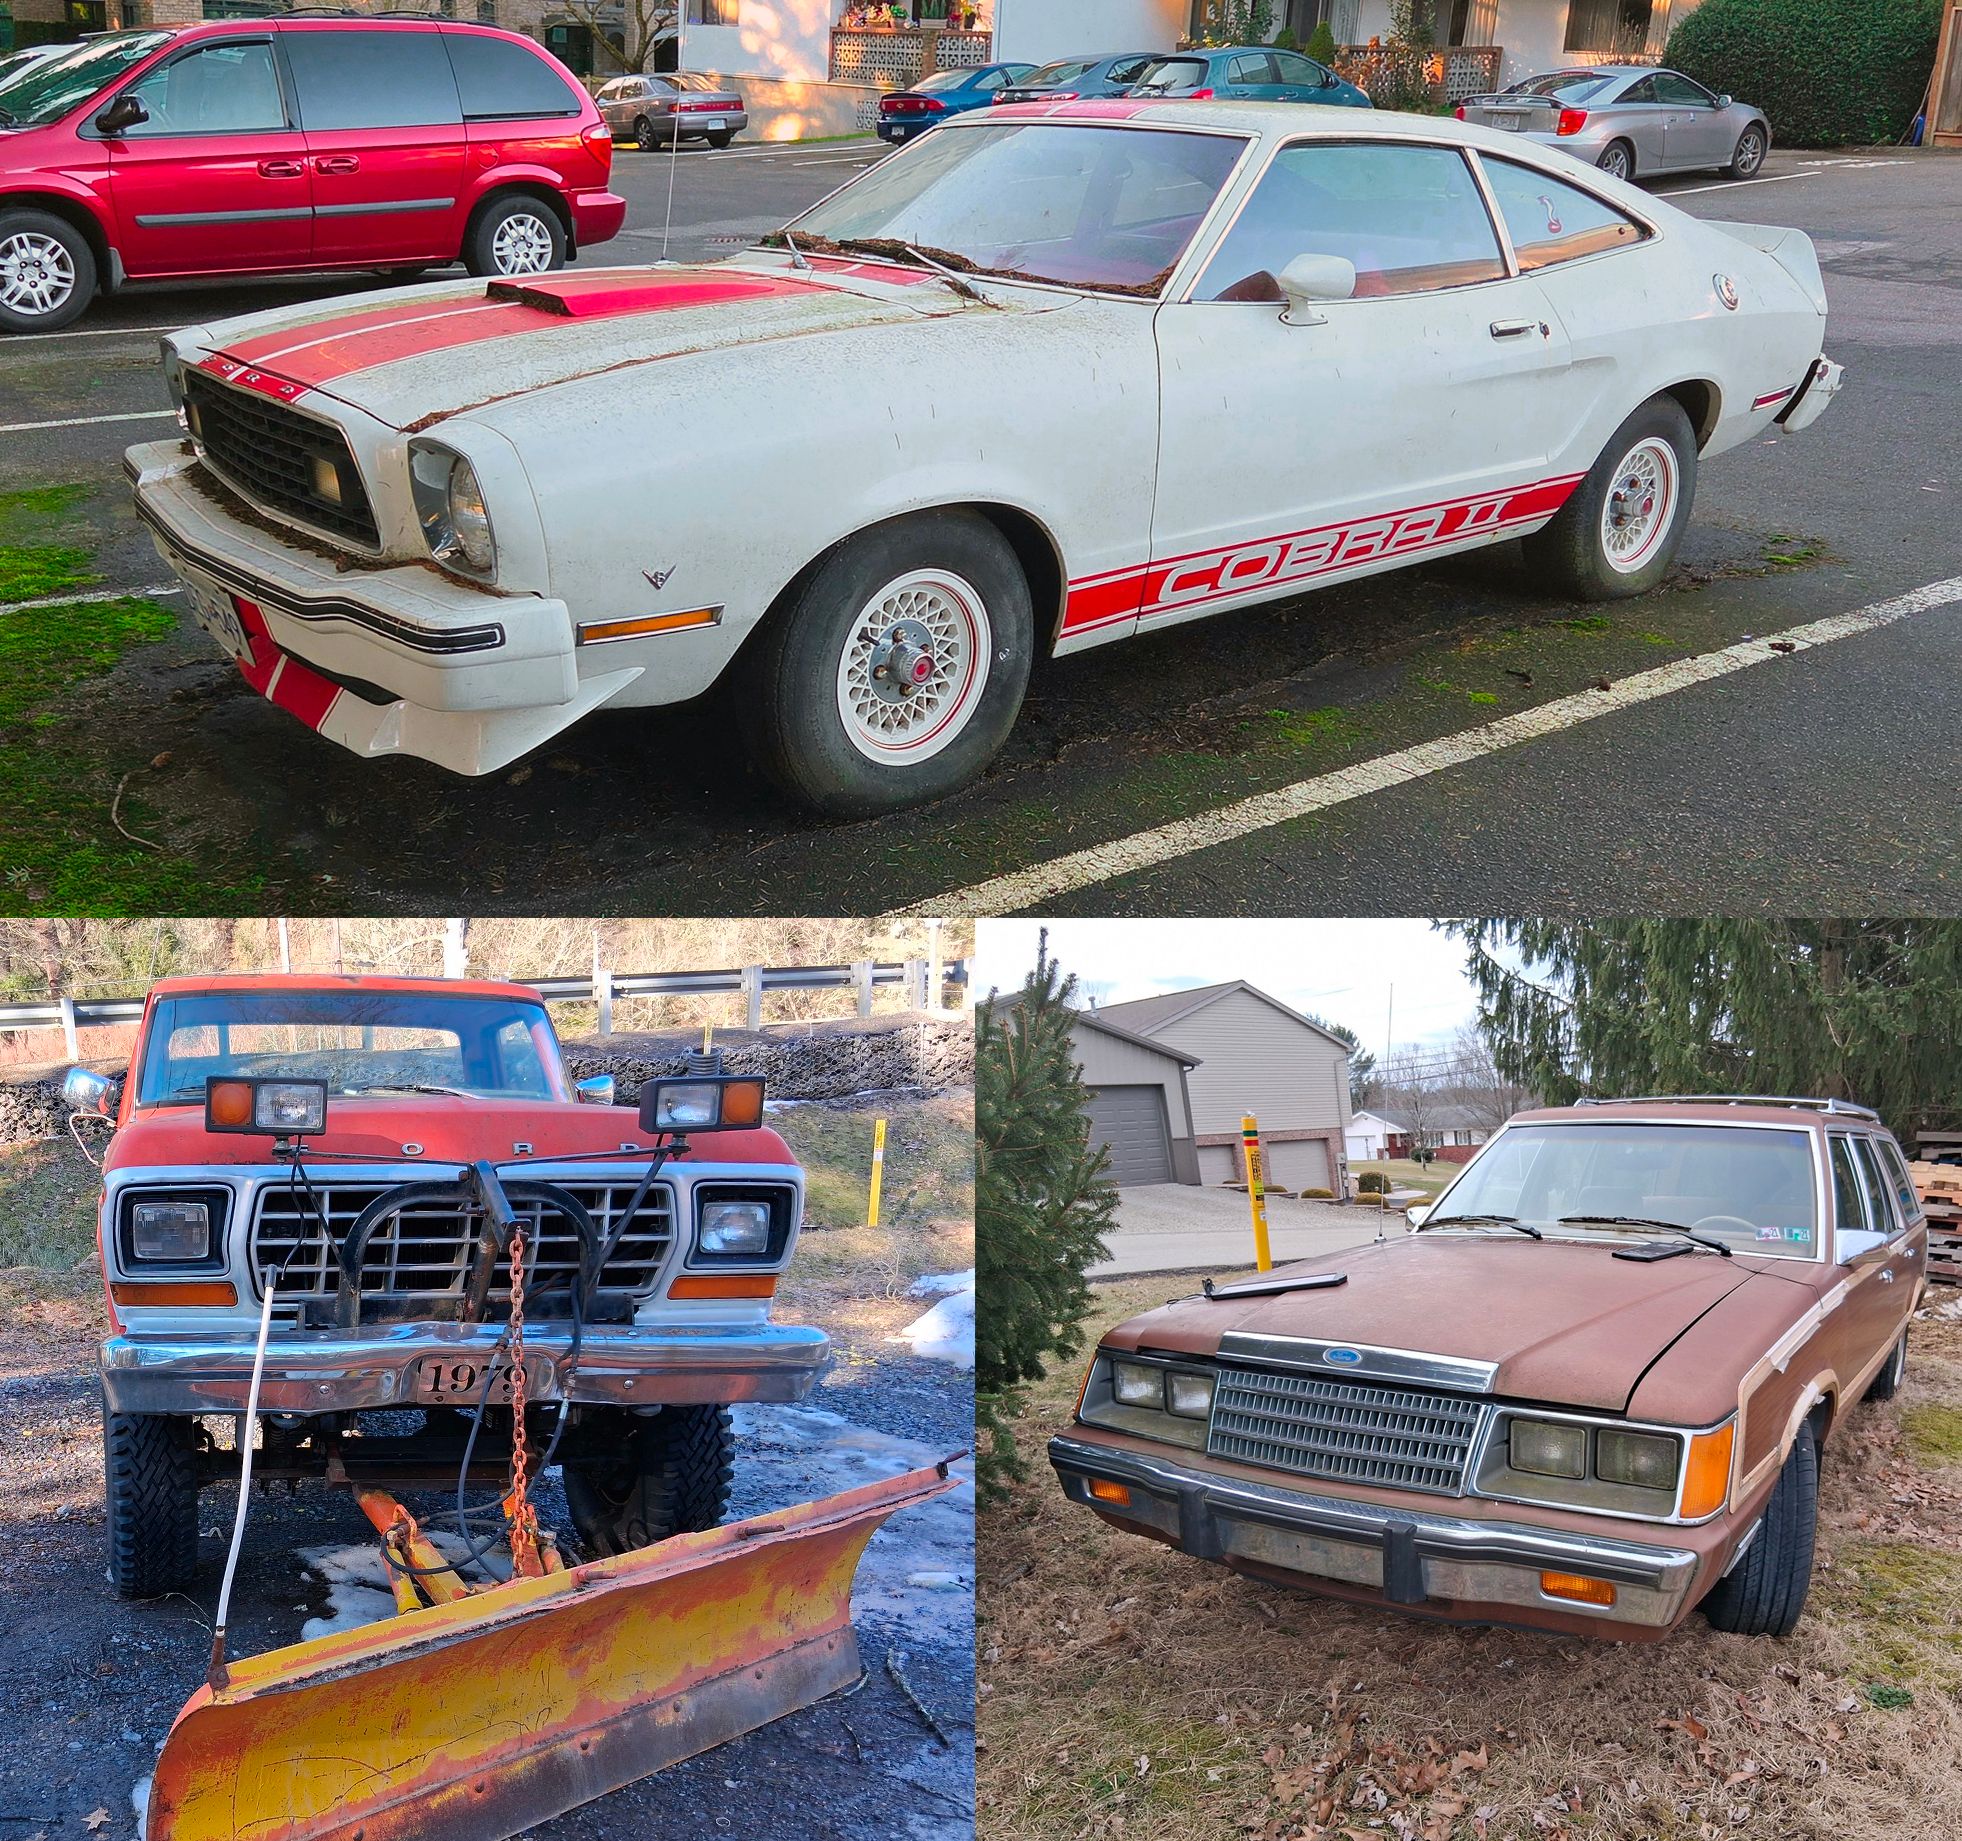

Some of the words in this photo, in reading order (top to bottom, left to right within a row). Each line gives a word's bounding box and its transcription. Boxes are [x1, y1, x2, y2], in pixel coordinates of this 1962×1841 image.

[1157, 507, 1448, 603] COBRA
[1453, 495, 1514, 532] II
[423, 1363, 528, 1394] 1979
